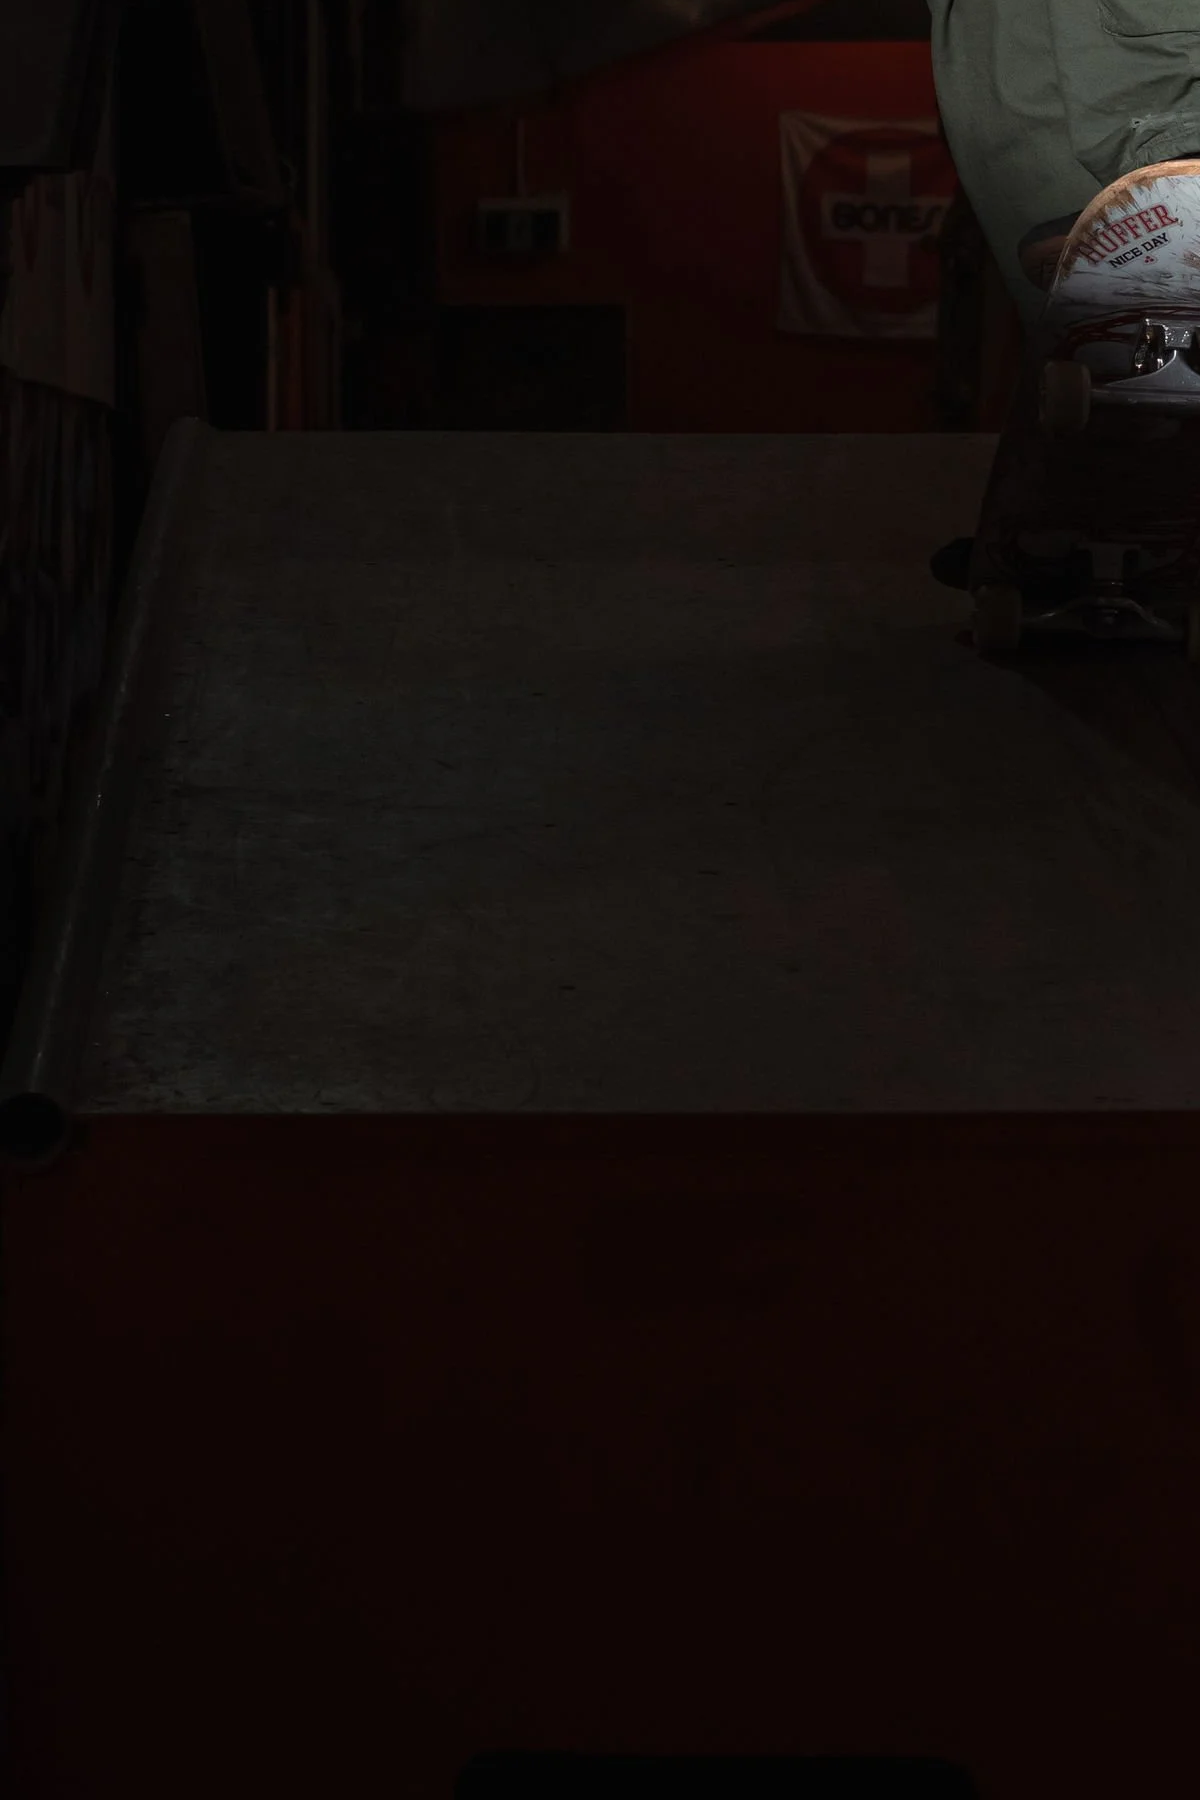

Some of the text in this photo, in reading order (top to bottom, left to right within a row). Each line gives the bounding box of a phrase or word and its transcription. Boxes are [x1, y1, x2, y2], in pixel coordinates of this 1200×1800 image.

[1078, 203, 1178, 264] HUFFER
[1108, 232, 1170, 268] NICE DAY
